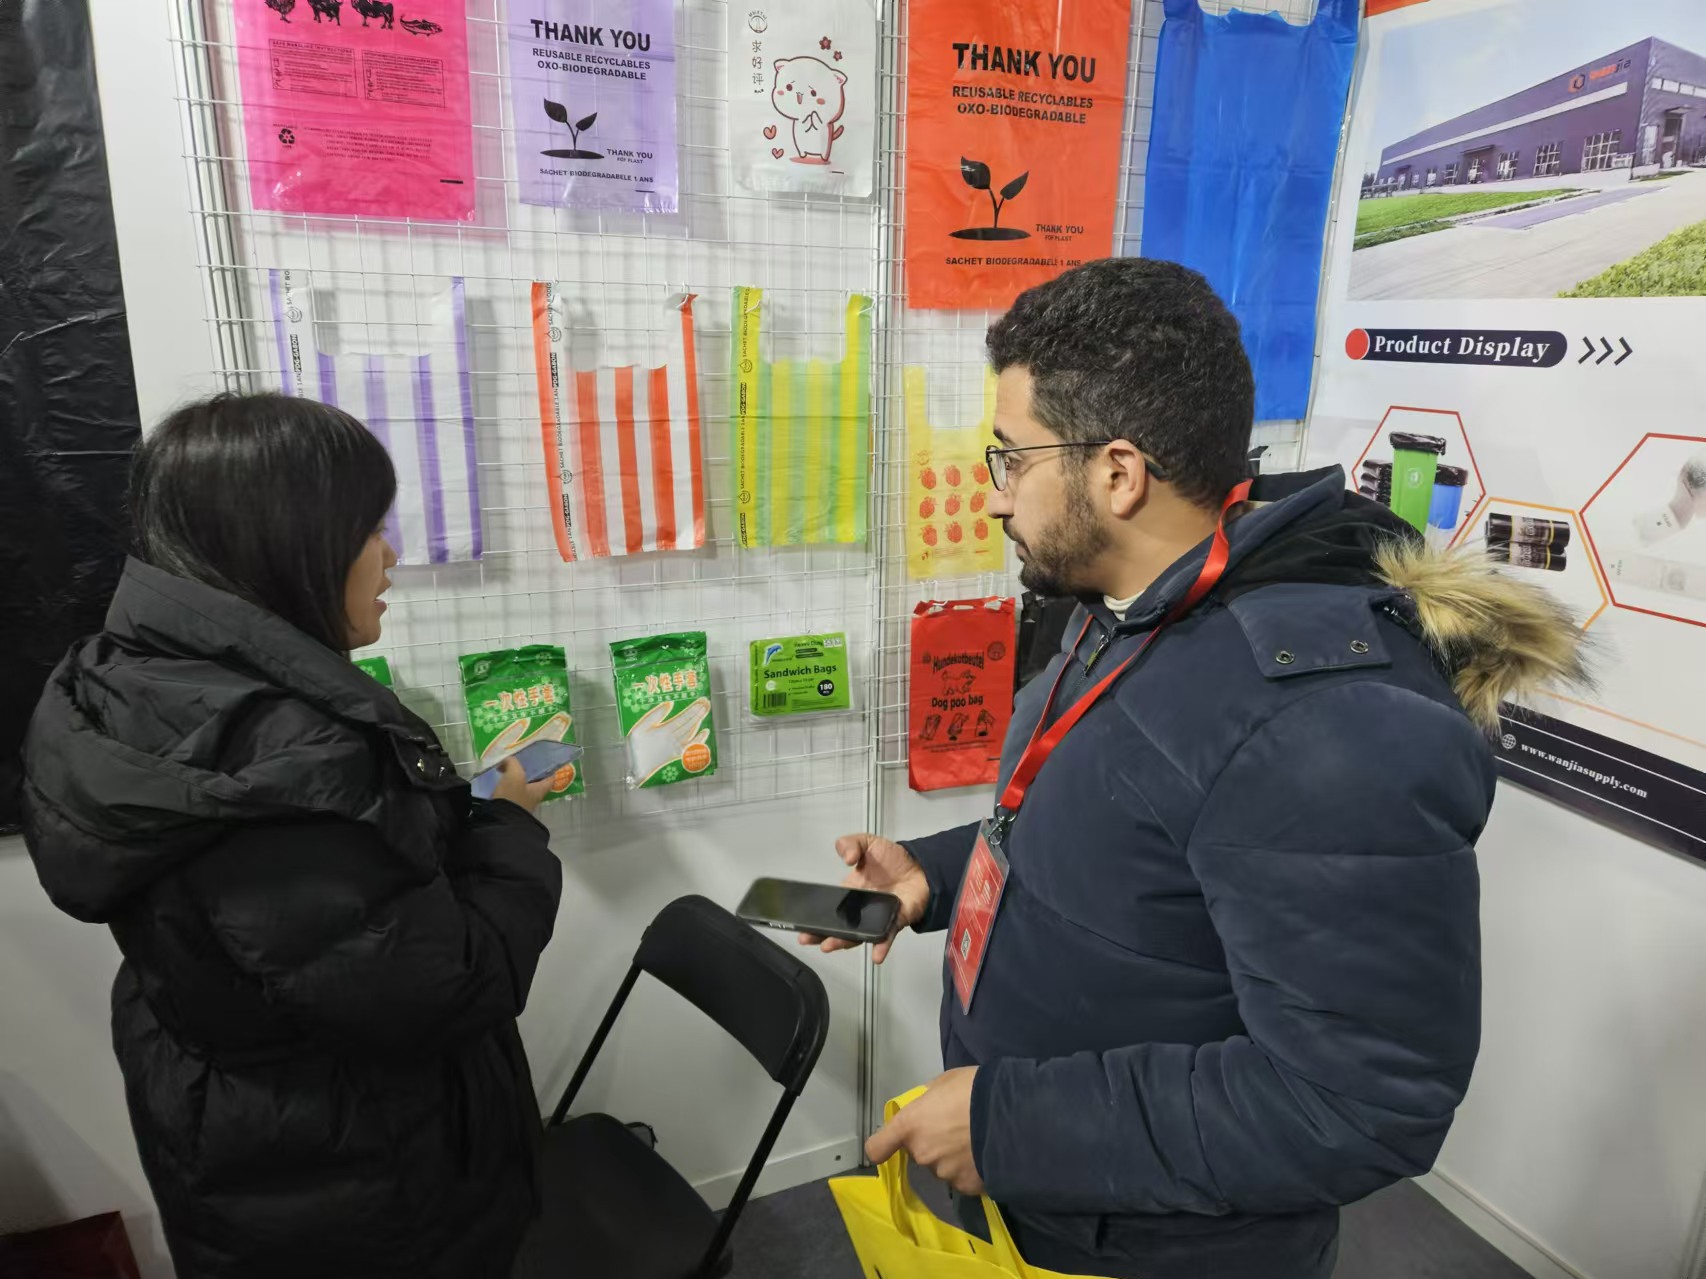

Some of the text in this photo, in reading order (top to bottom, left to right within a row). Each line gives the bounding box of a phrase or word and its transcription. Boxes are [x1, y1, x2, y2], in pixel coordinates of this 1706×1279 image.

[530, 19, 650, 52] THANK YOU
[532, 48, 650, 70] REUSABLE RECYCLABLES
[538, 60, 647, 80] OXO-BIODEGRADABLE
[752, 40, 764, 85] 求好评
[952, 43, 1096, 83] THANK YOU
[952, 86, 1093, 109] REUSABLE RECYCLABLES
[957, 102, 1086, 124] OXO-BIODEGRADABLE
[606, 148, 653, 160] THANK YOU
[540, 168, 568, 176] SACHET
[1036, 224, 1084, 234] THANK YOU
[946, 256, 982, 266] SACHET
[1374, 335, 1550, 363] Product Display
[550, 352, 558, 388] PDG-GABON
[764, 664, 837, 678] Sandwich Bags
[932, 694, 984, 711] Dog poo bag
[1521, 744, 1648, 798] www.wanjiasupply.com
